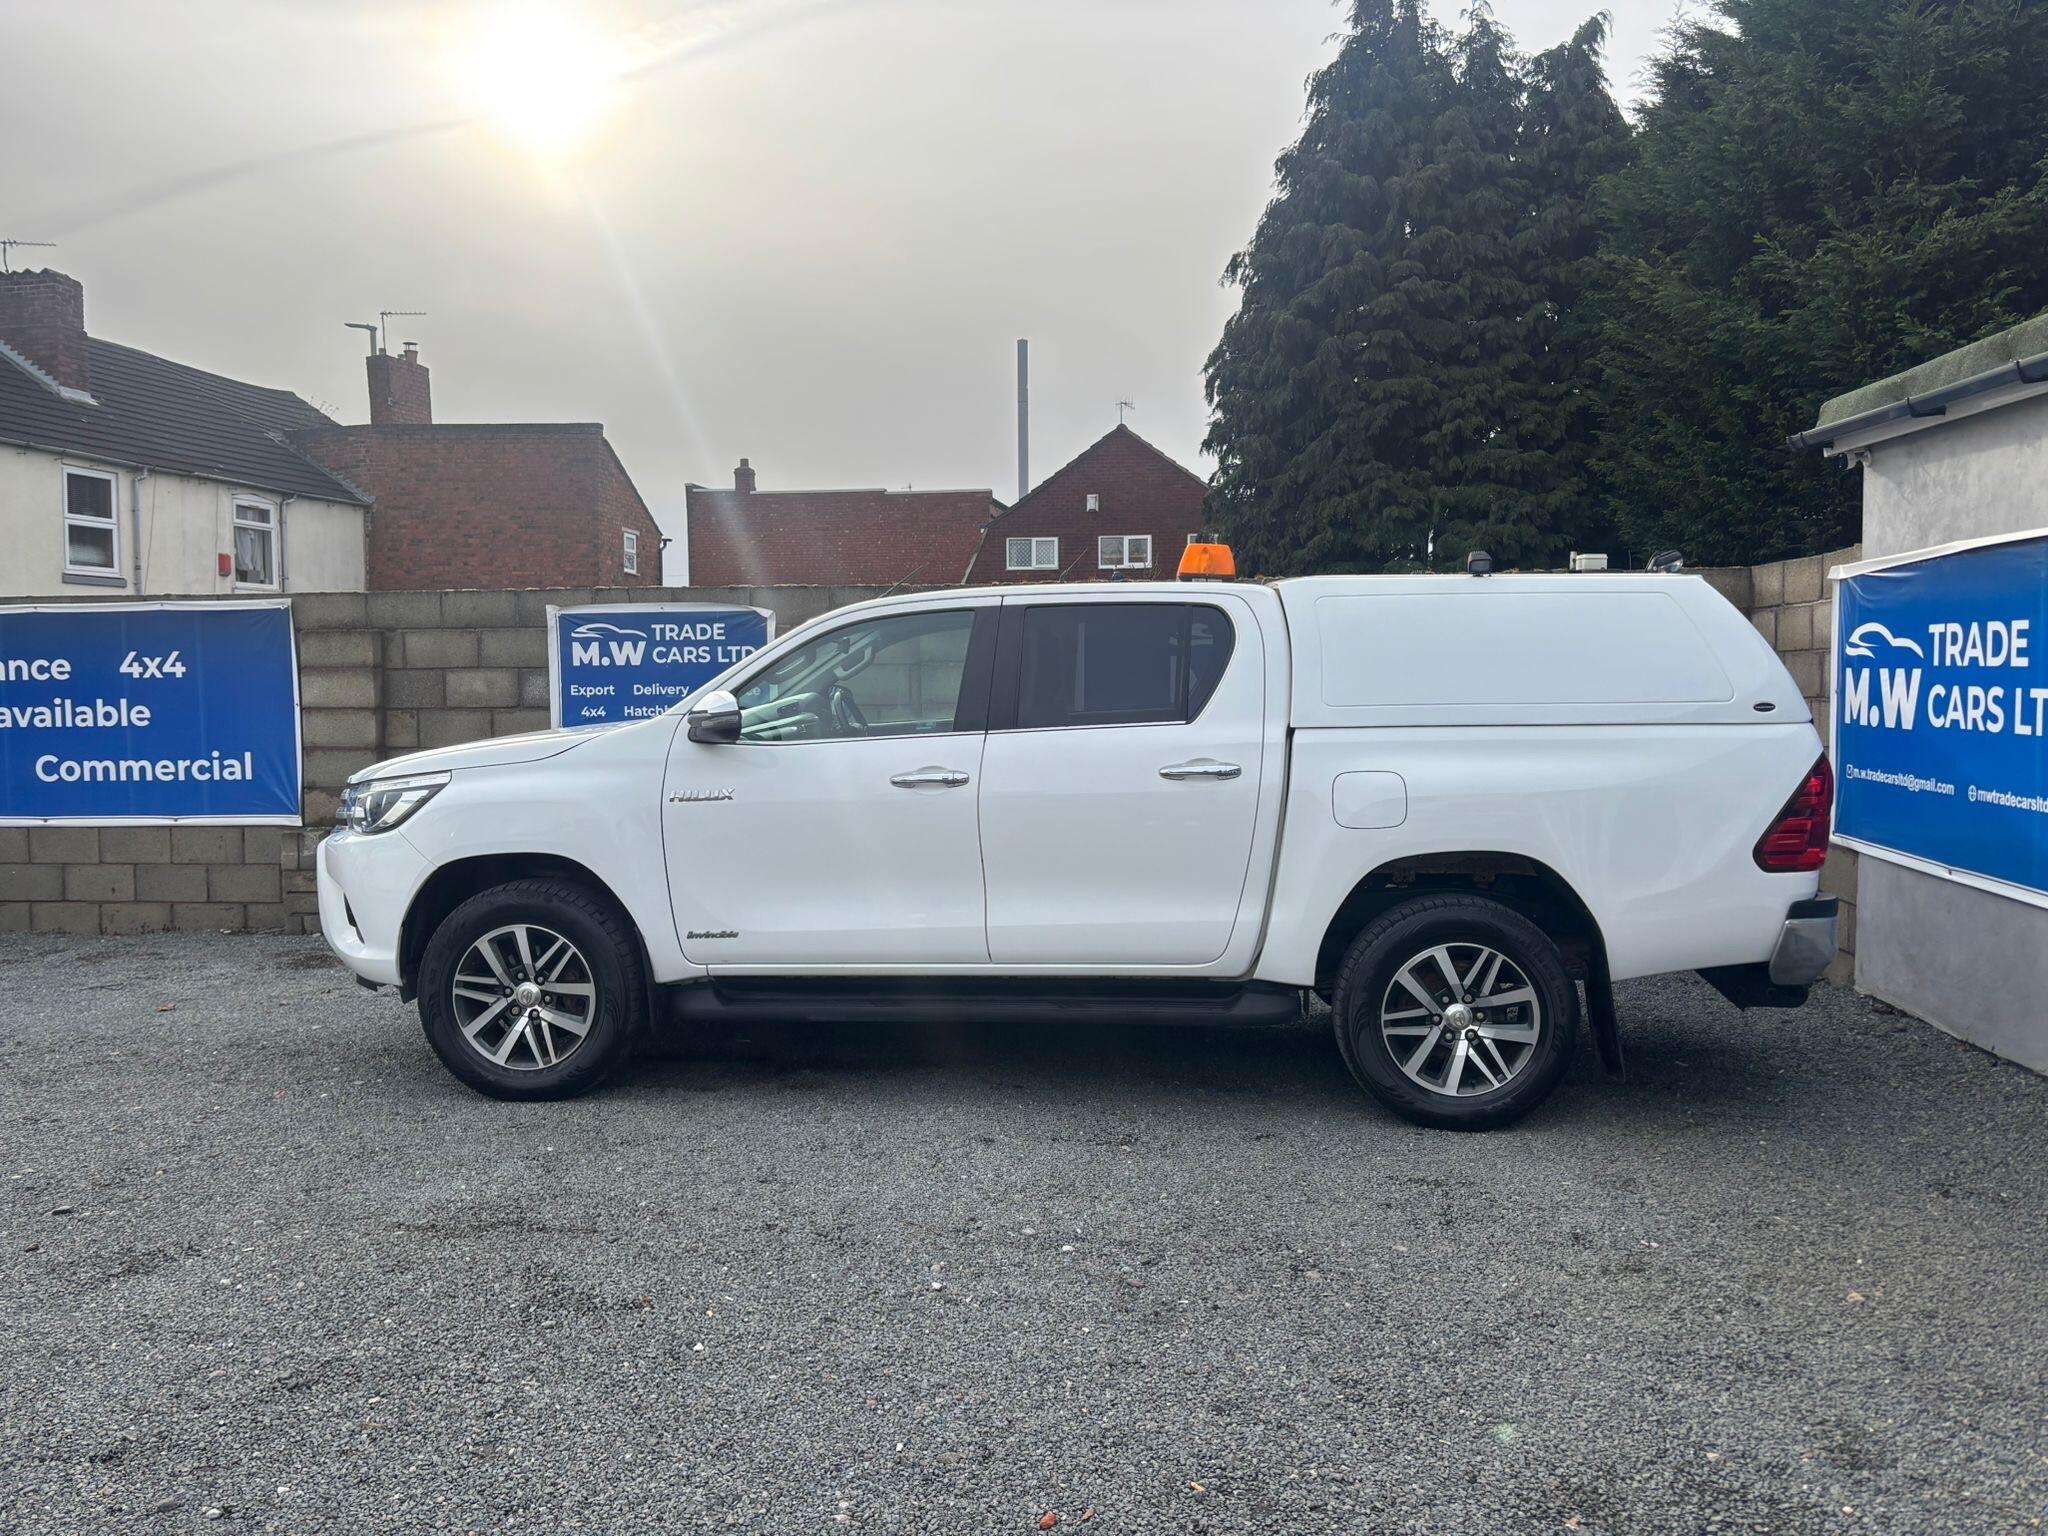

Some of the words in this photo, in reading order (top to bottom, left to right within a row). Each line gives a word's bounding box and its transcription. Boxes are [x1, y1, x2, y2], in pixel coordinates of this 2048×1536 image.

[651, 623, 726, 641] TRADE
[1928, 619, 2030, 667] TRADE
[119, 650, 187, 679] 4x4
[571, 640, 647, 666] M.W
[652, 646, 711, 663] CARS
[570, 684, 615, 697] Export
[633, 683, 690, 697] Delivery
[1844, 666, 1922, 730] M.W
[0, 697, 152, 728] available
[581, 705, 606, 718] 4x4
[1927, 685, 2005, 733] CARS
[35, 750, 253, 782] Commercial
